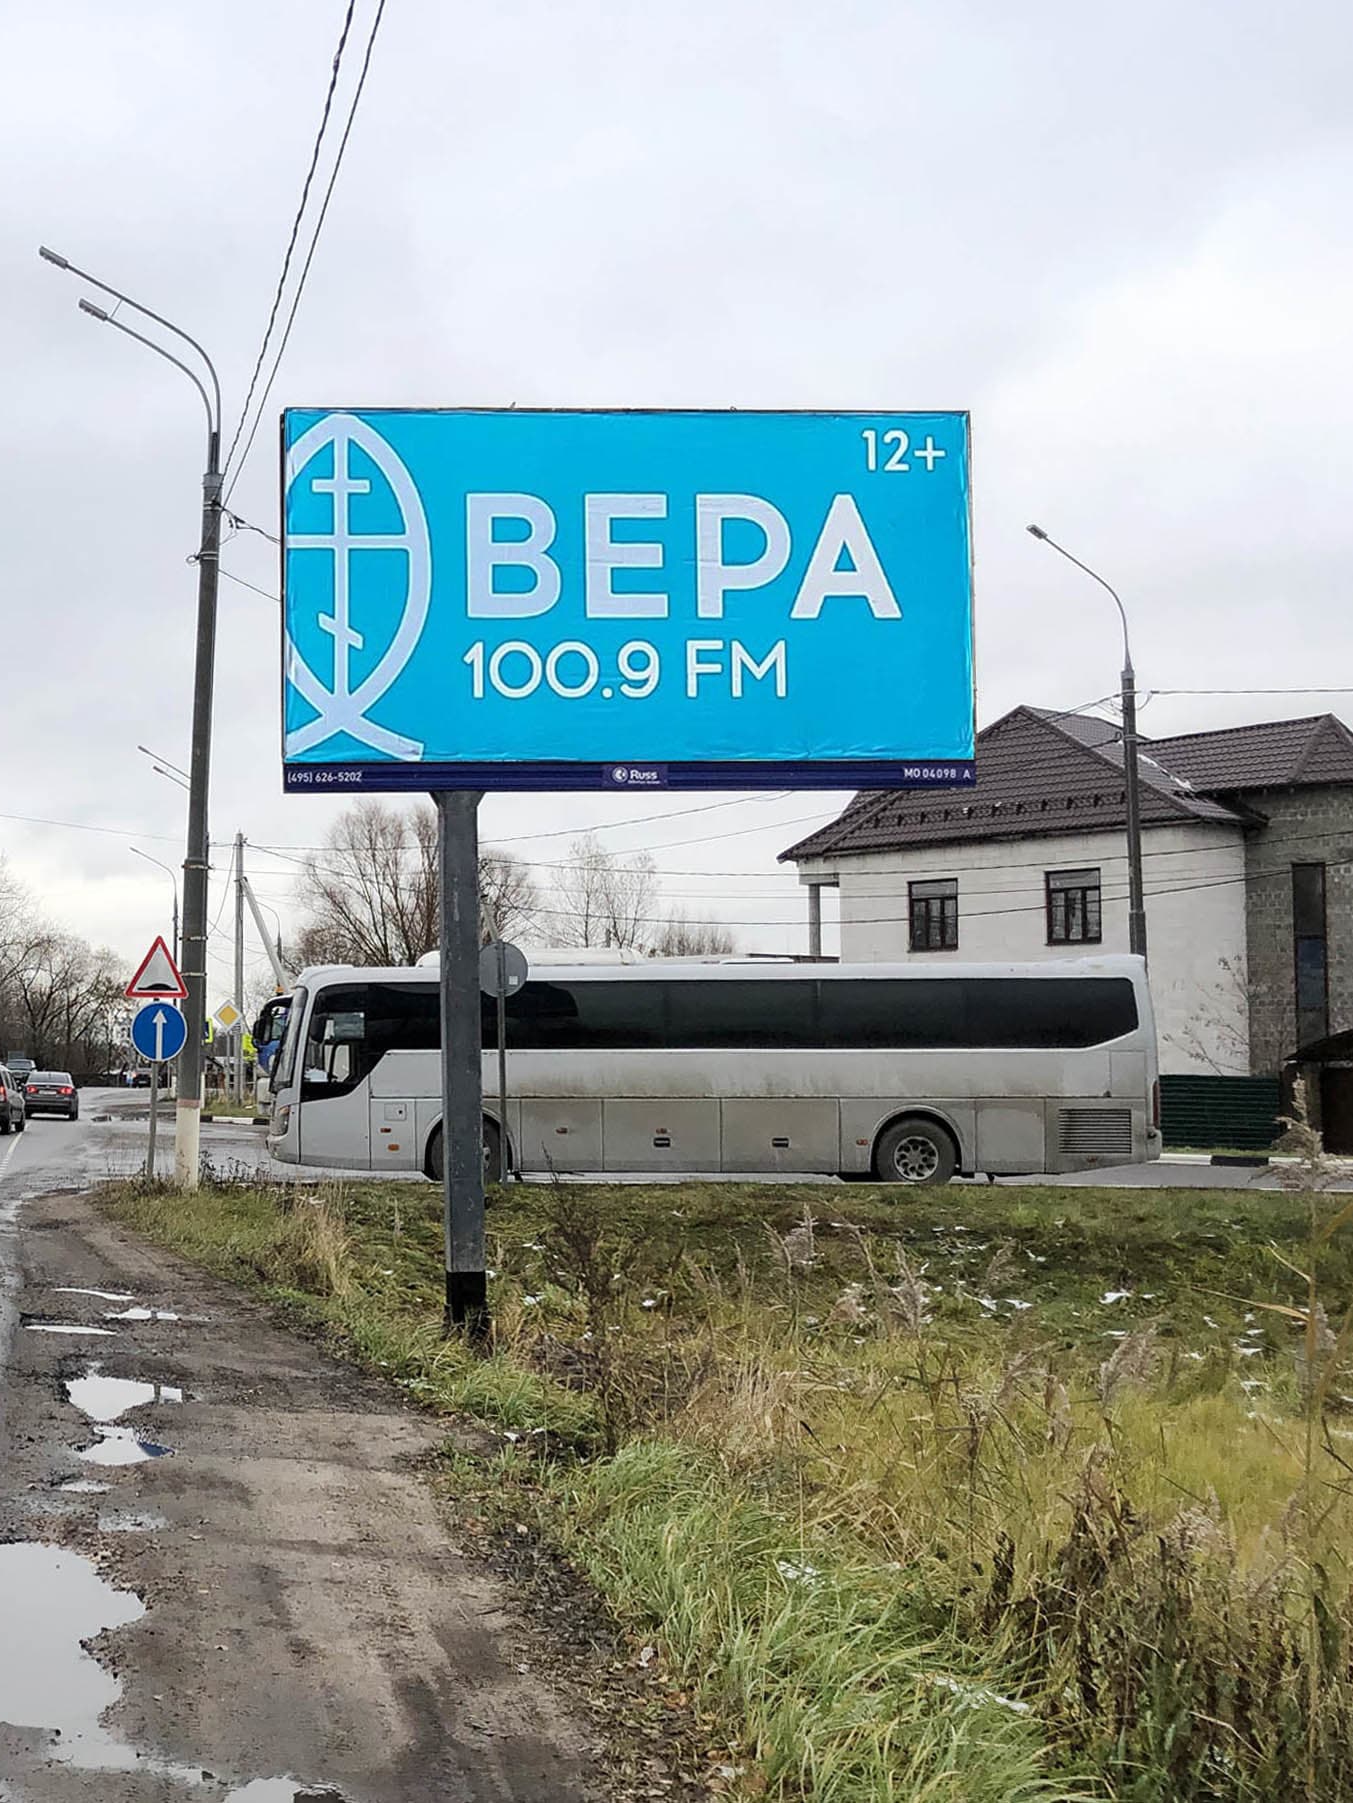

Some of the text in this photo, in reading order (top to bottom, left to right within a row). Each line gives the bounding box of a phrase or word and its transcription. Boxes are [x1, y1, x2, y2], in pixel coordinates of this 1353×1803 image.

[861, 429, 946, 472] 12+
[465, 492, 904, 620] ВЕРА
[462, 640, 788, 699] 100.9 FM
[287, 771, 363, 783] (495) 626-5202
[629, 769, 659, 780] Russ
